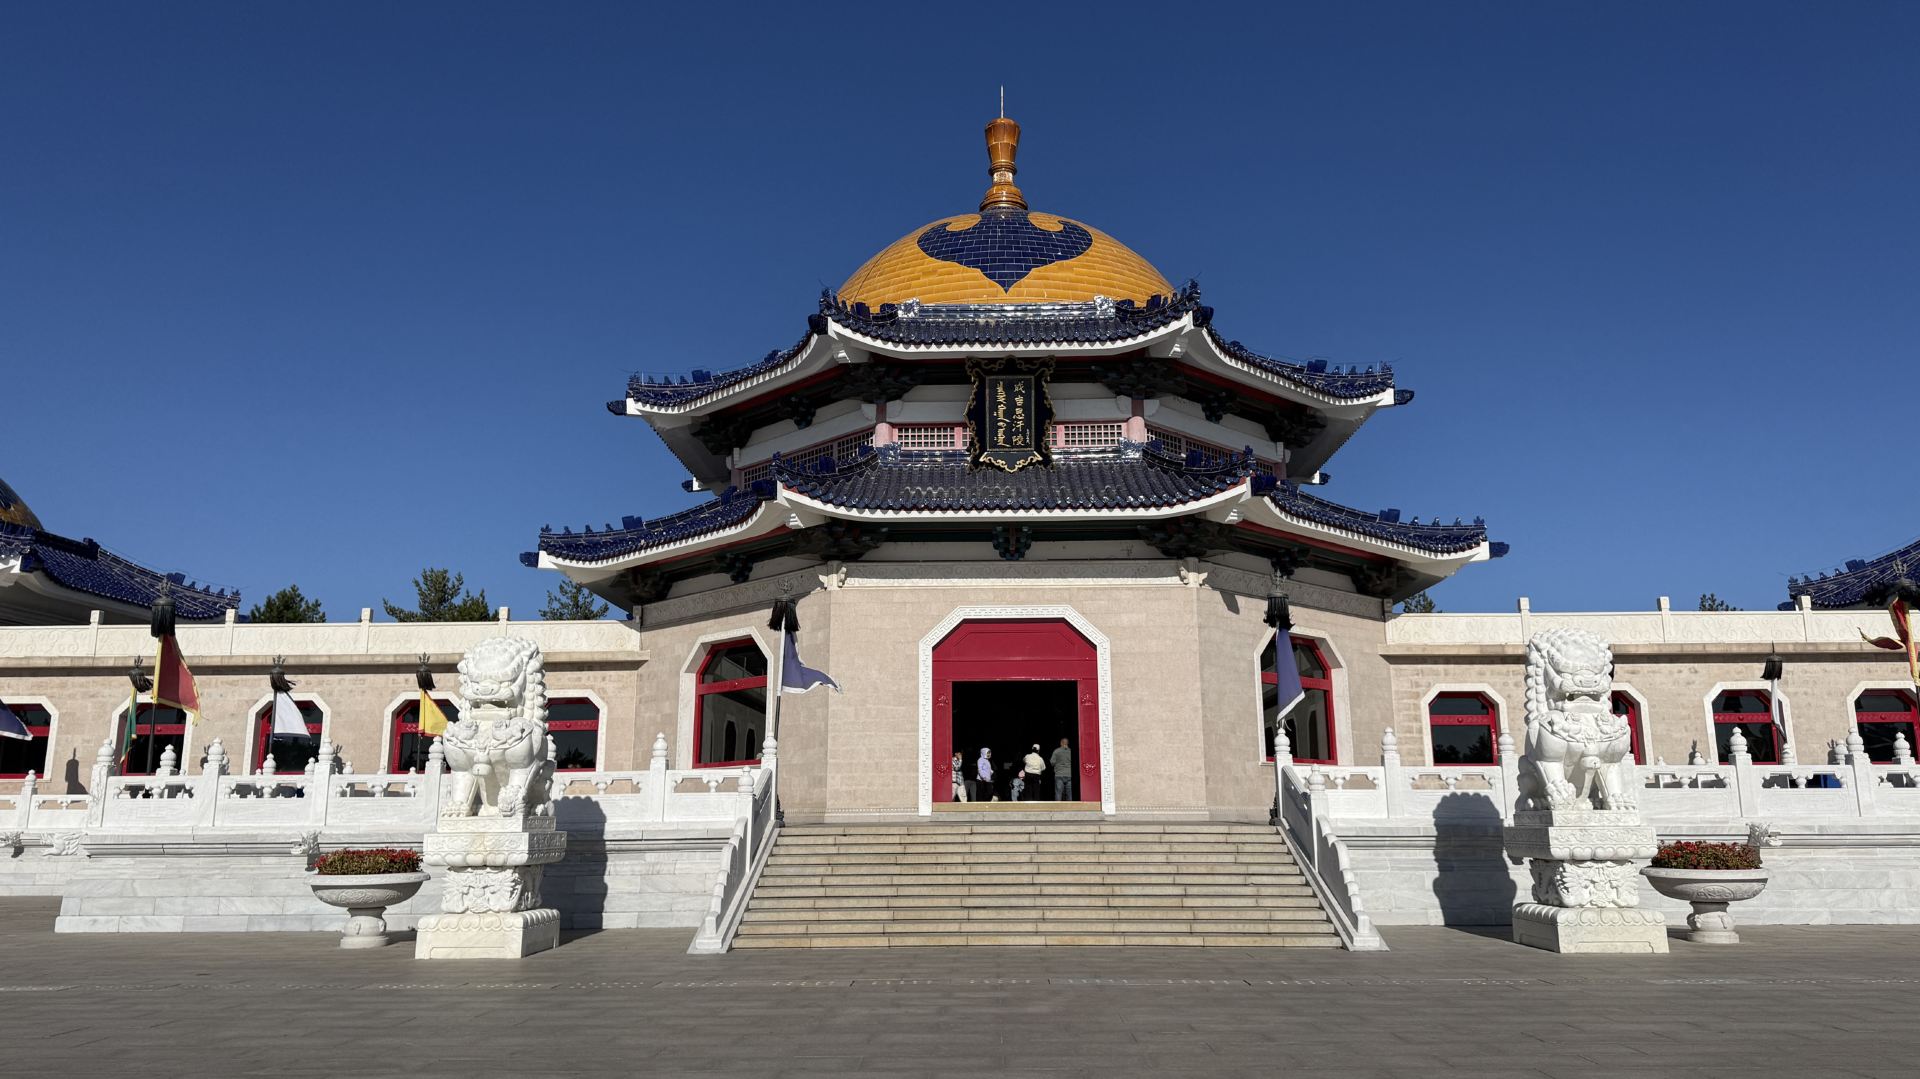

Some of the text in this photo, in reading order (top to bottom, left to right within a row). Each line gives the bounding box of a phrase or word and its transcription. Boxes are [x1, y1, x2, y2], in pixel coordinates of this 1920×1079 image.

[1012, 380, 1025, 446] 成吉思汗陵
